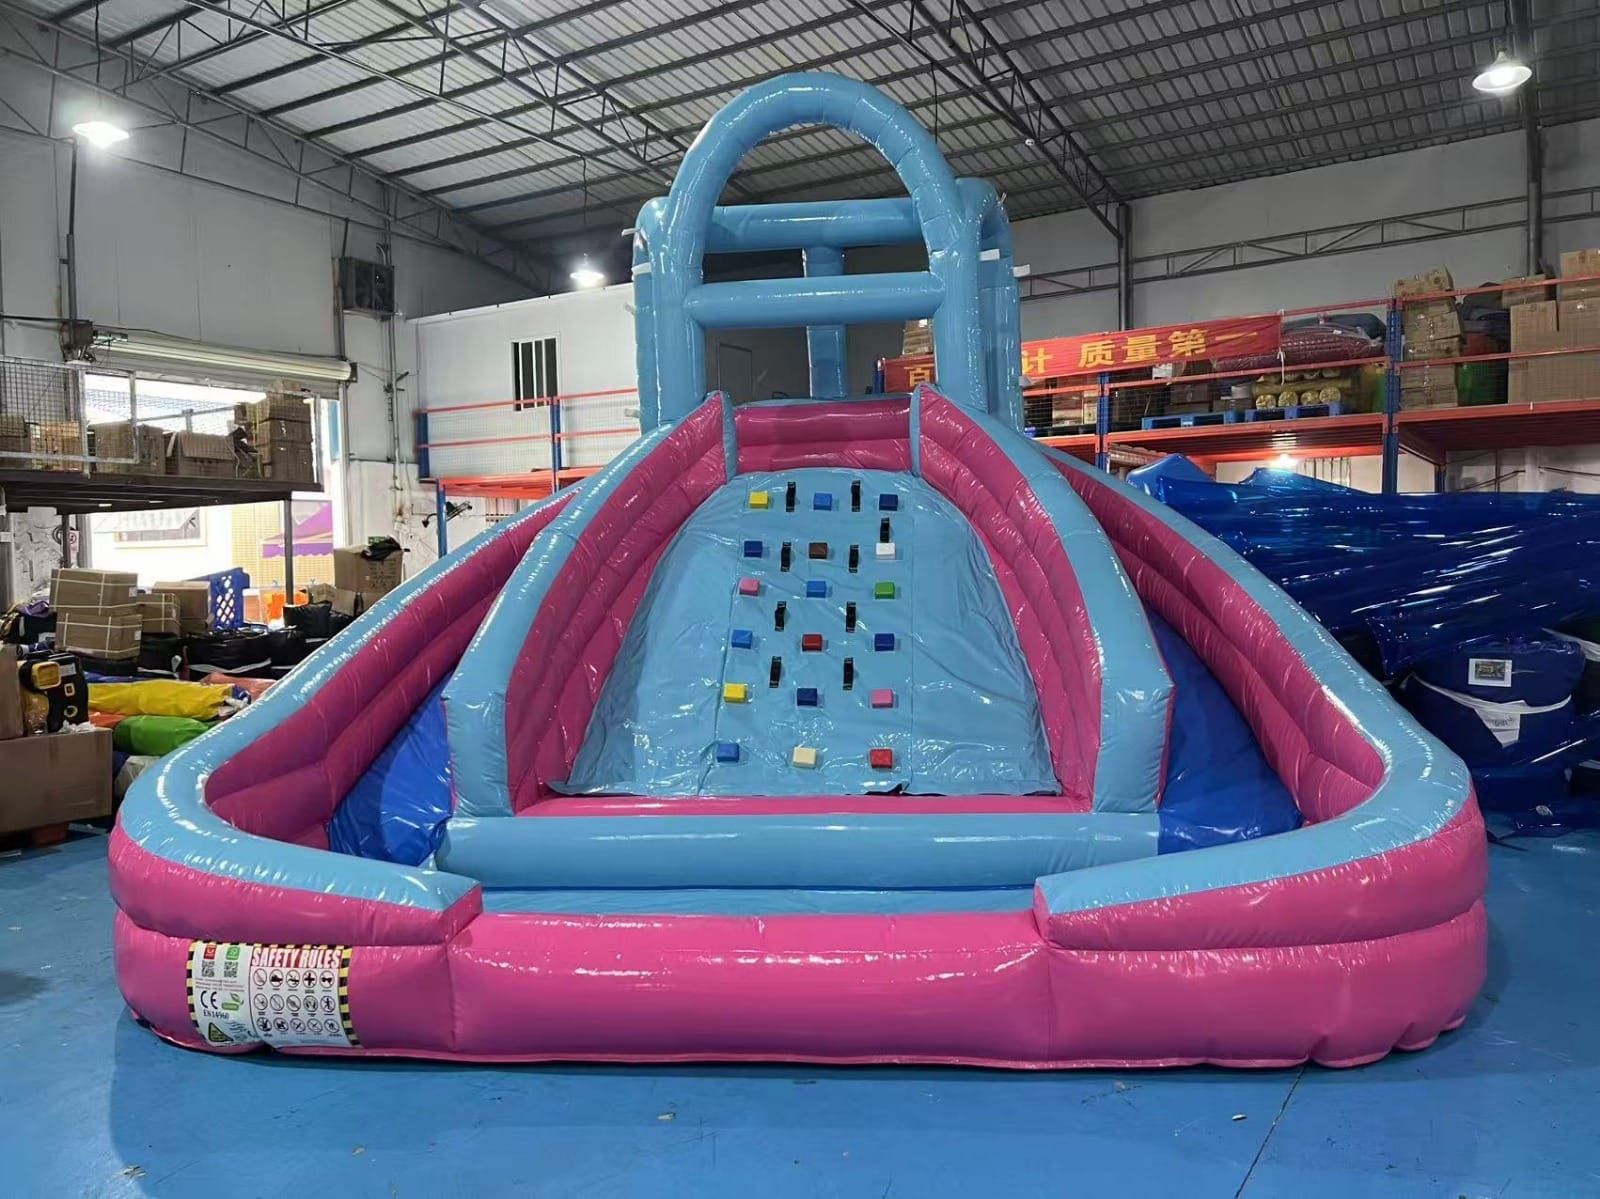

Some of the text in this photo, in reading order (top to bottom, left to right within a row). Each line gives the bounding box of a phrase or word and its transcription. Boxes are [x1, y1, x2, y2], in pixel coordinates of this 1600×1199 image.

[1078, 328, 1258, 368] 质量第一
[251, 947, 342, 969] SAFETY RULES
[200, 990, 218, 1010] CE
